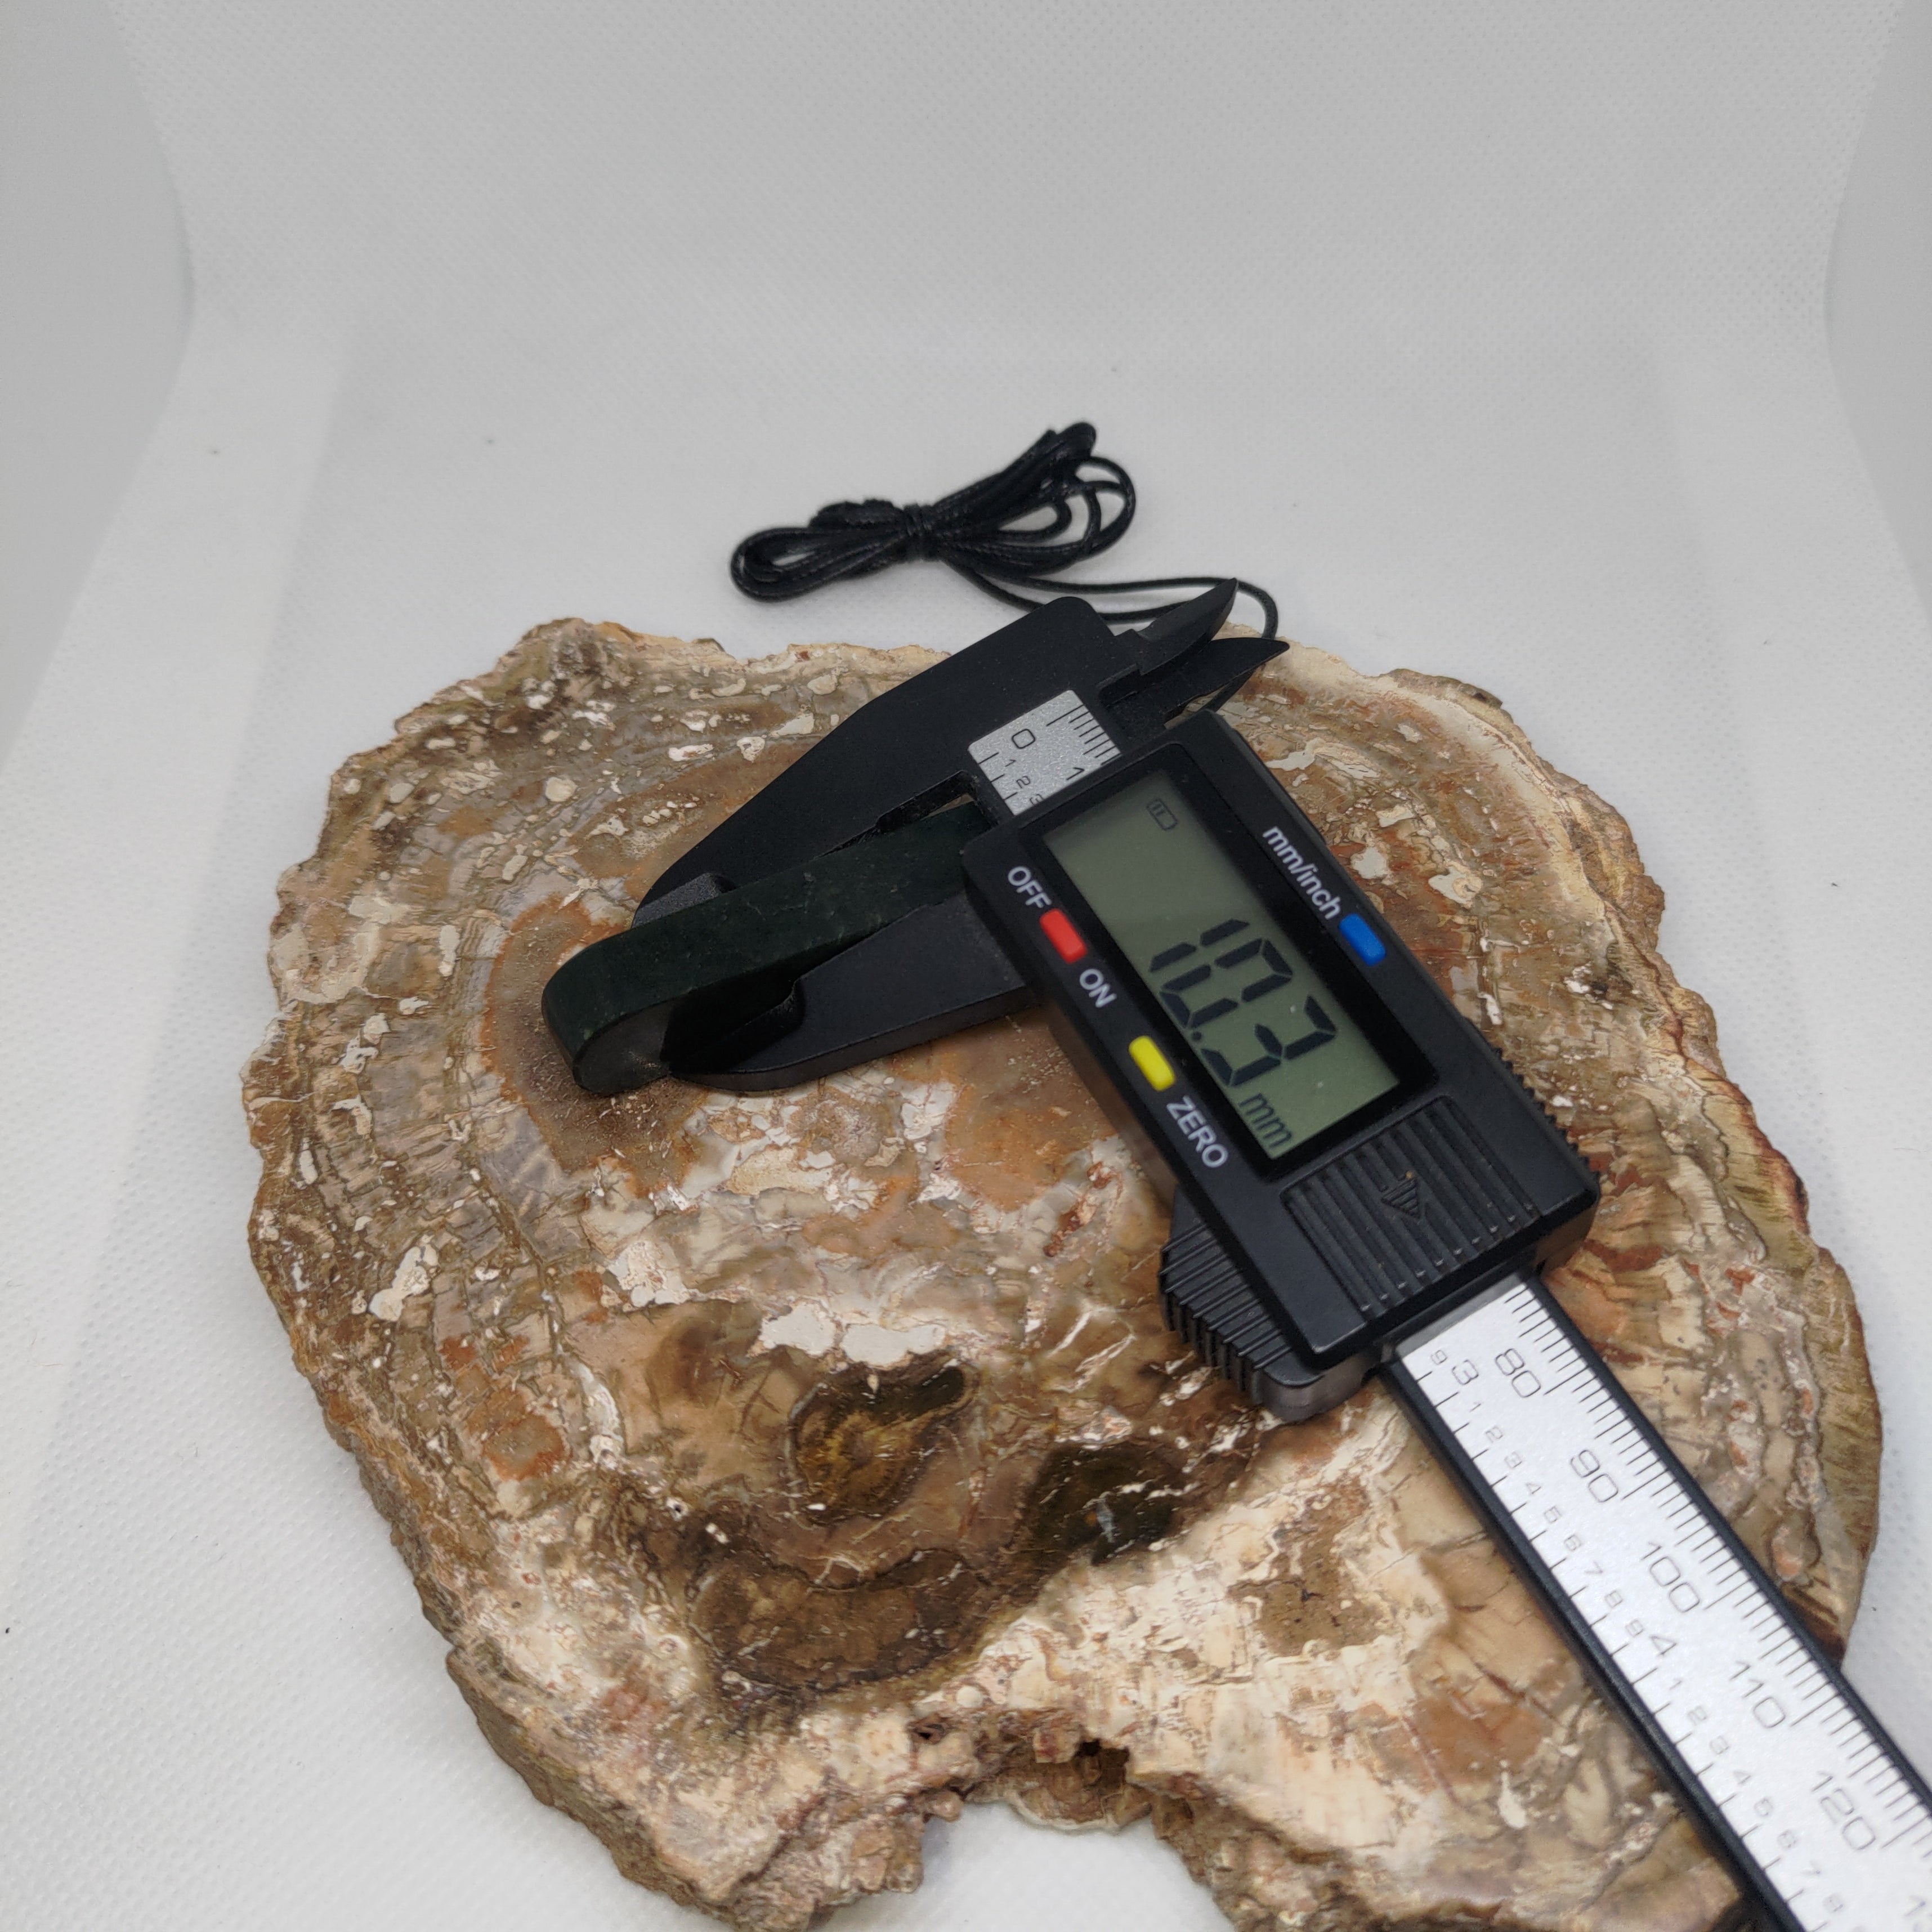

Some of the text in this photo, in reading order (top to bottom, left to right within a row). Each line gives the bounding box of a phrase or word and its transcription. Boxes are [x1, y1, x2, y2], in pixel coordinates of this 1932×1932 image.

[1011, 728, 1036, 749] 0
[1004, 759, 1016, 767] 1
[1016, 775, 1031, 789] 2
[1007, 866, 1052, 909] OFF
[1262, 826, 1343, 920] mm/inch
[1079, 968, 1117, 1008] ON
[1166, 1095, 1229, 1168] ZERO
[1239, 1092, 1293, 1151] mm
[1451, 1359, 1479, 1385] 3
[1494, 1348, 1541, 1398] 80
[1469, 1401, 1482, 1412] 1
[1484, 1425, 1504, 1444] 2
[1525, 1481, 1541, 1495] 4
[1570, 1449, 1619, 1503] 90
[1584, 1560, 1604, 1575] 7
[1641, 1541, 1700, 1613] 100
[1650, 1635, 1677, 1656] 4
[1728, 1660, 1786, 1729] 110
[1810, 1770, 1876, 1850] 120
